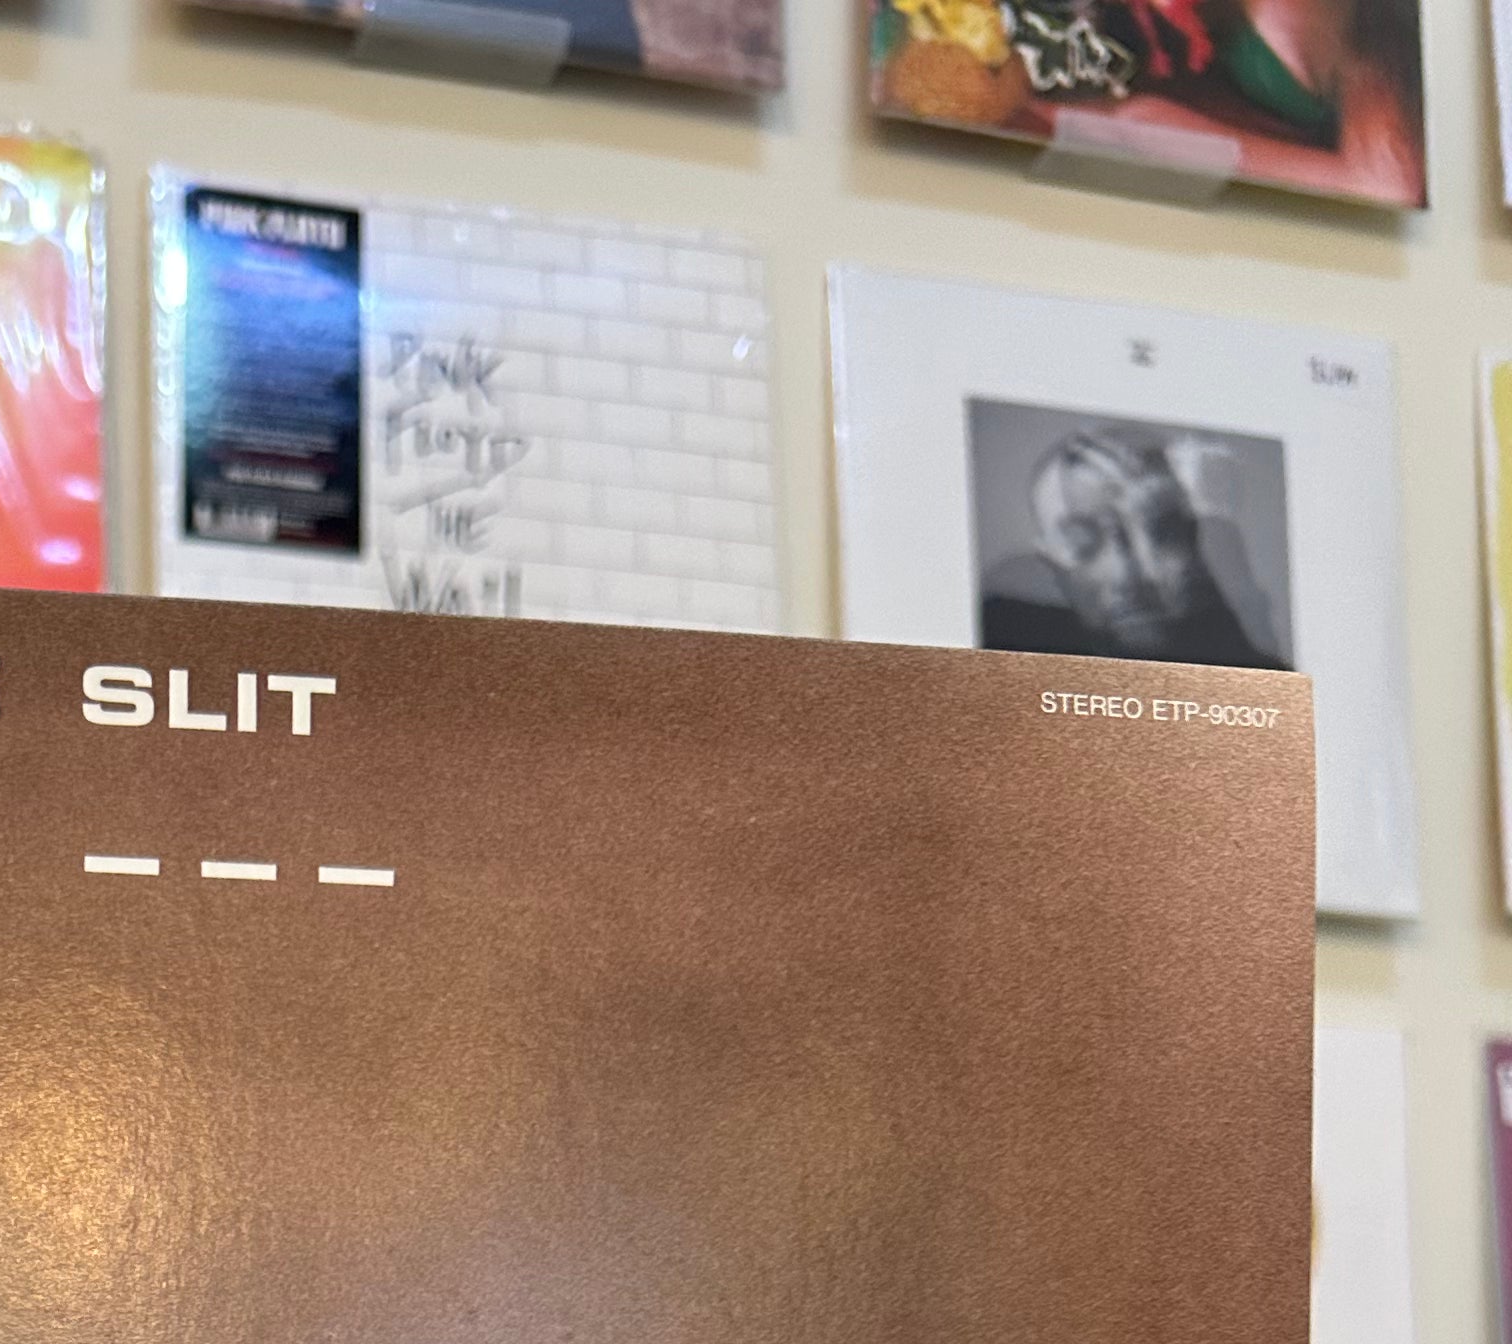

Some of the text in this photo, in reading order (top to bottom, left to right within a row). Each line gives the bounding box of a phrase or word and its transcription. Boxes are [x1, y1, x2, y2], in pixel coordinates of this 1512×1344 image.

[82, 664, 337, 736] SLIT
[1040, 691, 1281, 728] STEREO ETP-90307
